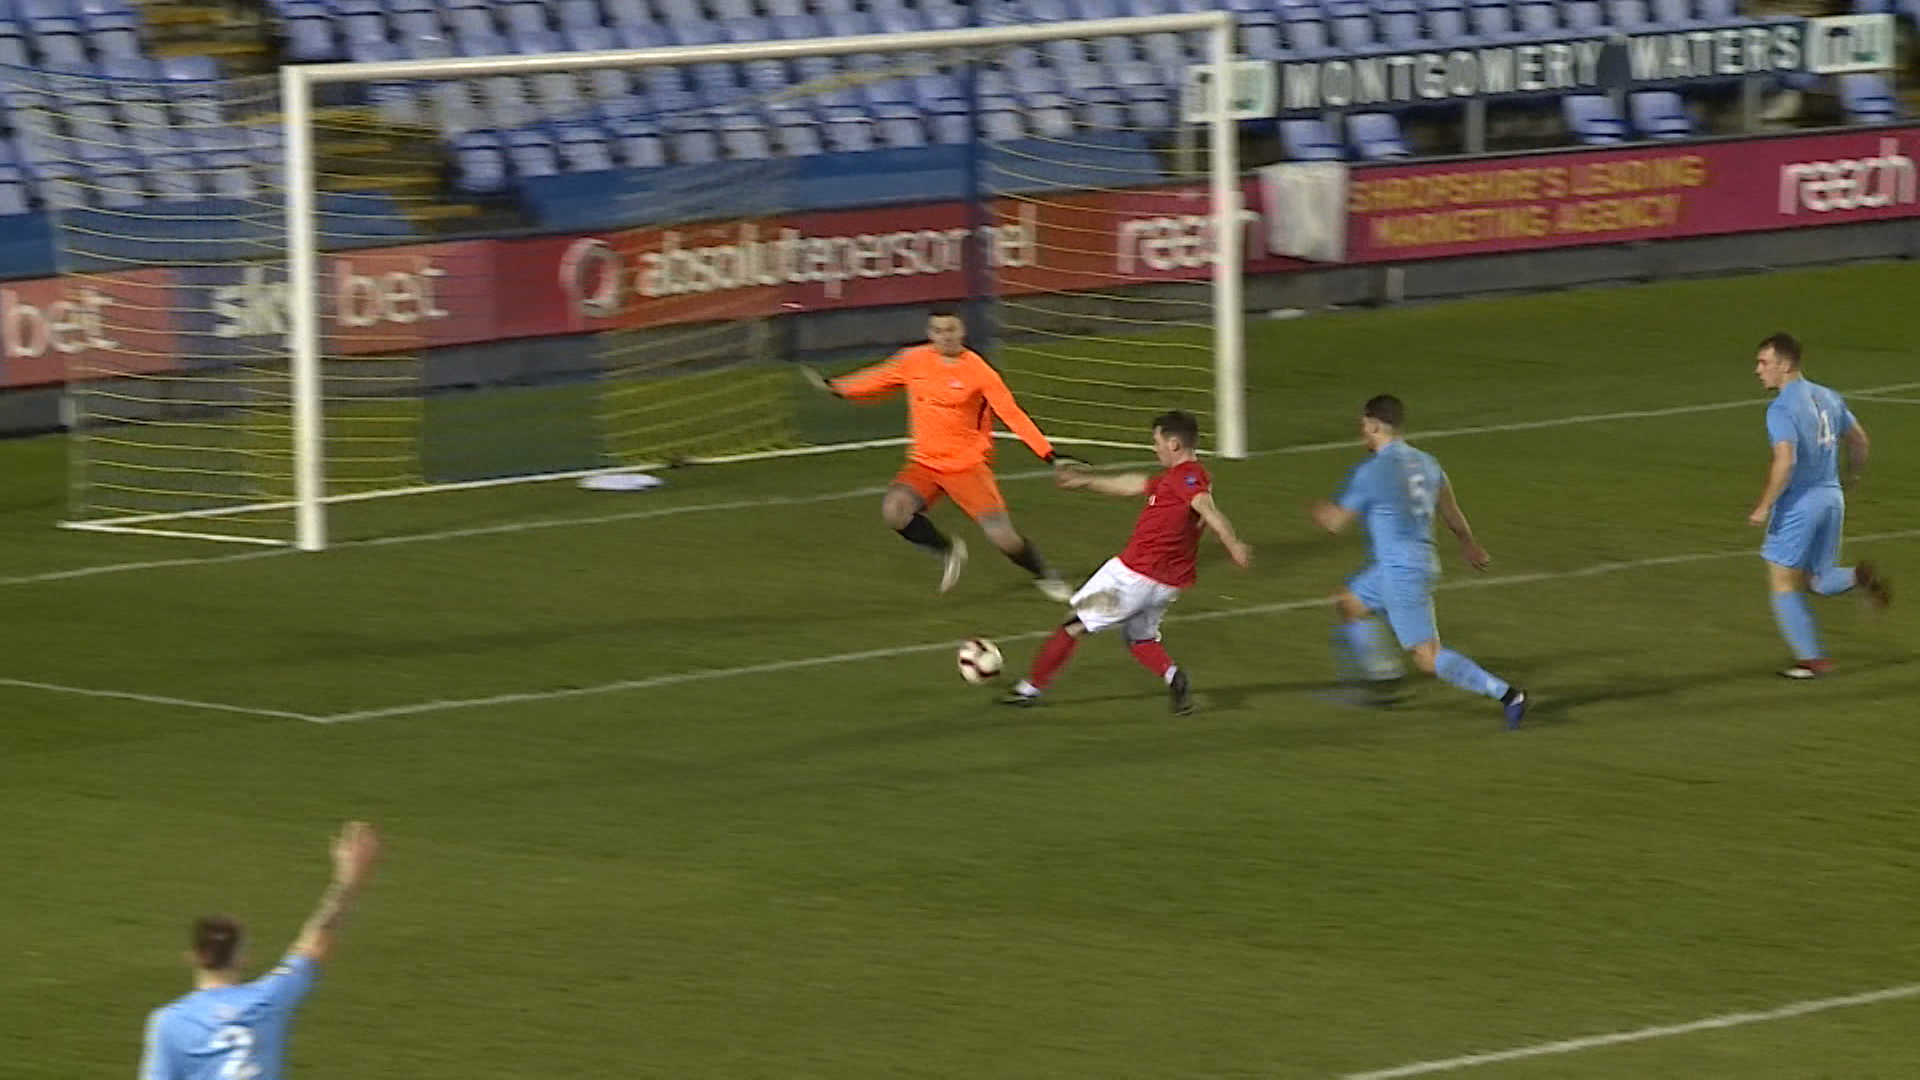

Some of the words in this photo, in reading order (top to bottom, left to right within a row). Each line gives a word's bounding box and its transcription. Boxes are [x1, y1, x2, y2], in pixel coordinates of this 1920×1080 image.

[1284, 43, 1597, 109] MONTGOMERY
[1628, 25, 1804, 81] WATERS
[1777, 137, 1918, 215] reach
[2, 289, 119, 358] bet
[335, 257, 449, 327] bet
[1817, 410, 1837, 446] 4
[1408, 474, 1434, 518] 5
[207, 1023, 263, 1080] 2
